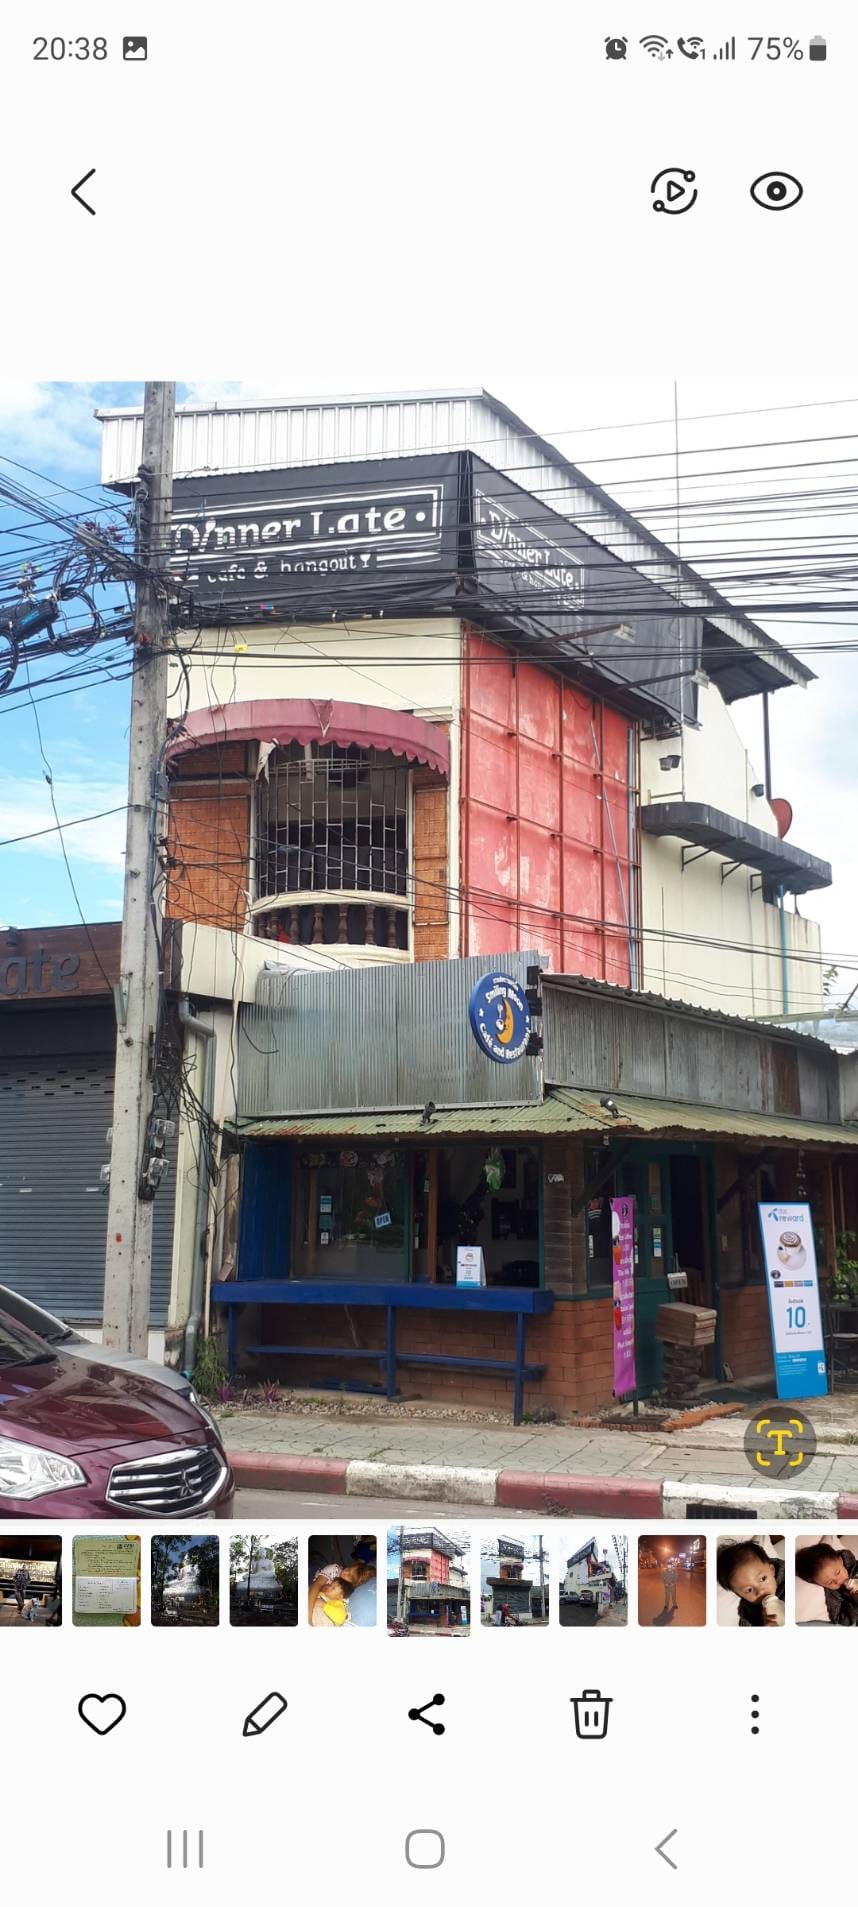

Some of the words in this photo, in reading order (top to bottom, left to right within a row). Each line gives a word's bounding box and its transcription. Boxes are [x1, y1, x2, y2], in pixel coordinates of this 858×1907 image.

[310, 506, 407, 534] Late
[485, 985, 507, 1003] Smiling
[507, 987, 524, 1012] Moon
[786, 1306, 806, 1329] 10
